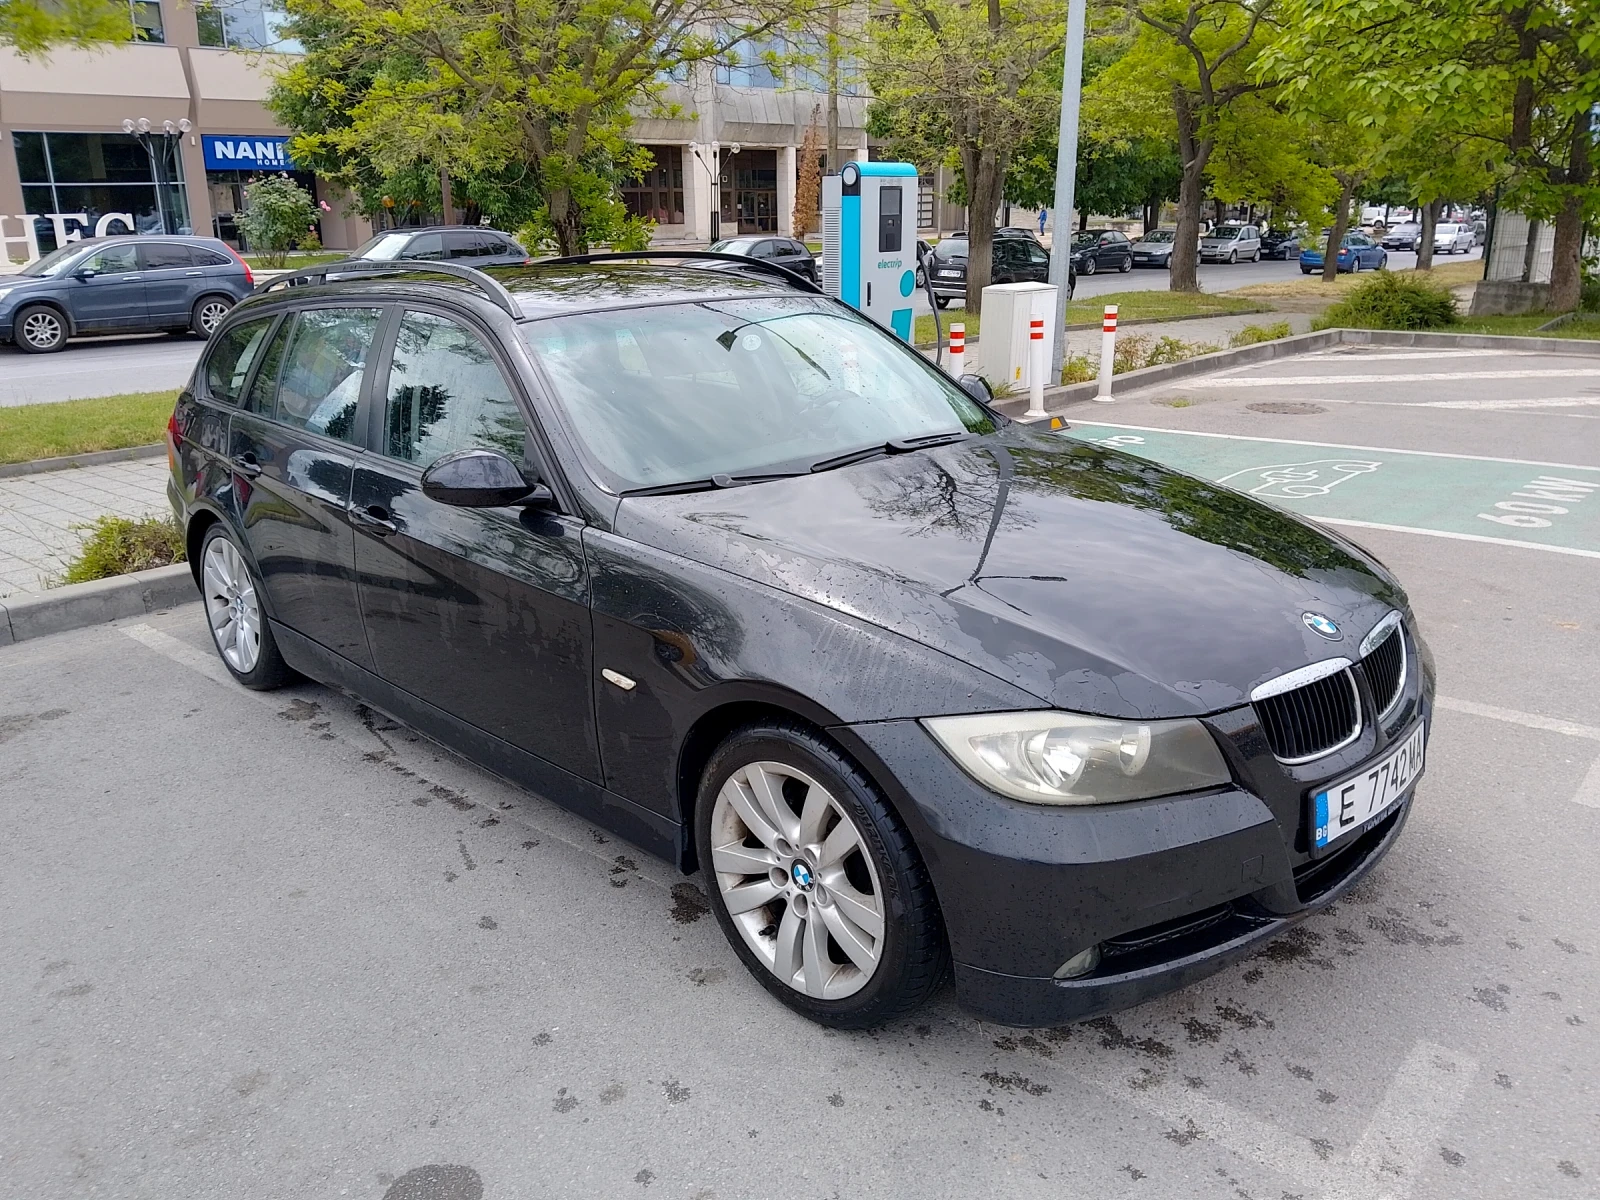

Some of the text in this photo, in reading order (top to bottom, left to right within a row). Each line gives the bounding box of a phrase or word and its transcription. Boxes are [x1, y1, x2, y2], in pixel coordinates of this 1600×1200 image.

[214, 141, 285, 160] NANI
[877, 258, 902, 270] electrip
[1339, 784, 1355, 827] E
[1368, 748, 1407, 813] 7742
[1409, 731, 1422, 777] MA
[1315, 826, 1328, 841] BG
